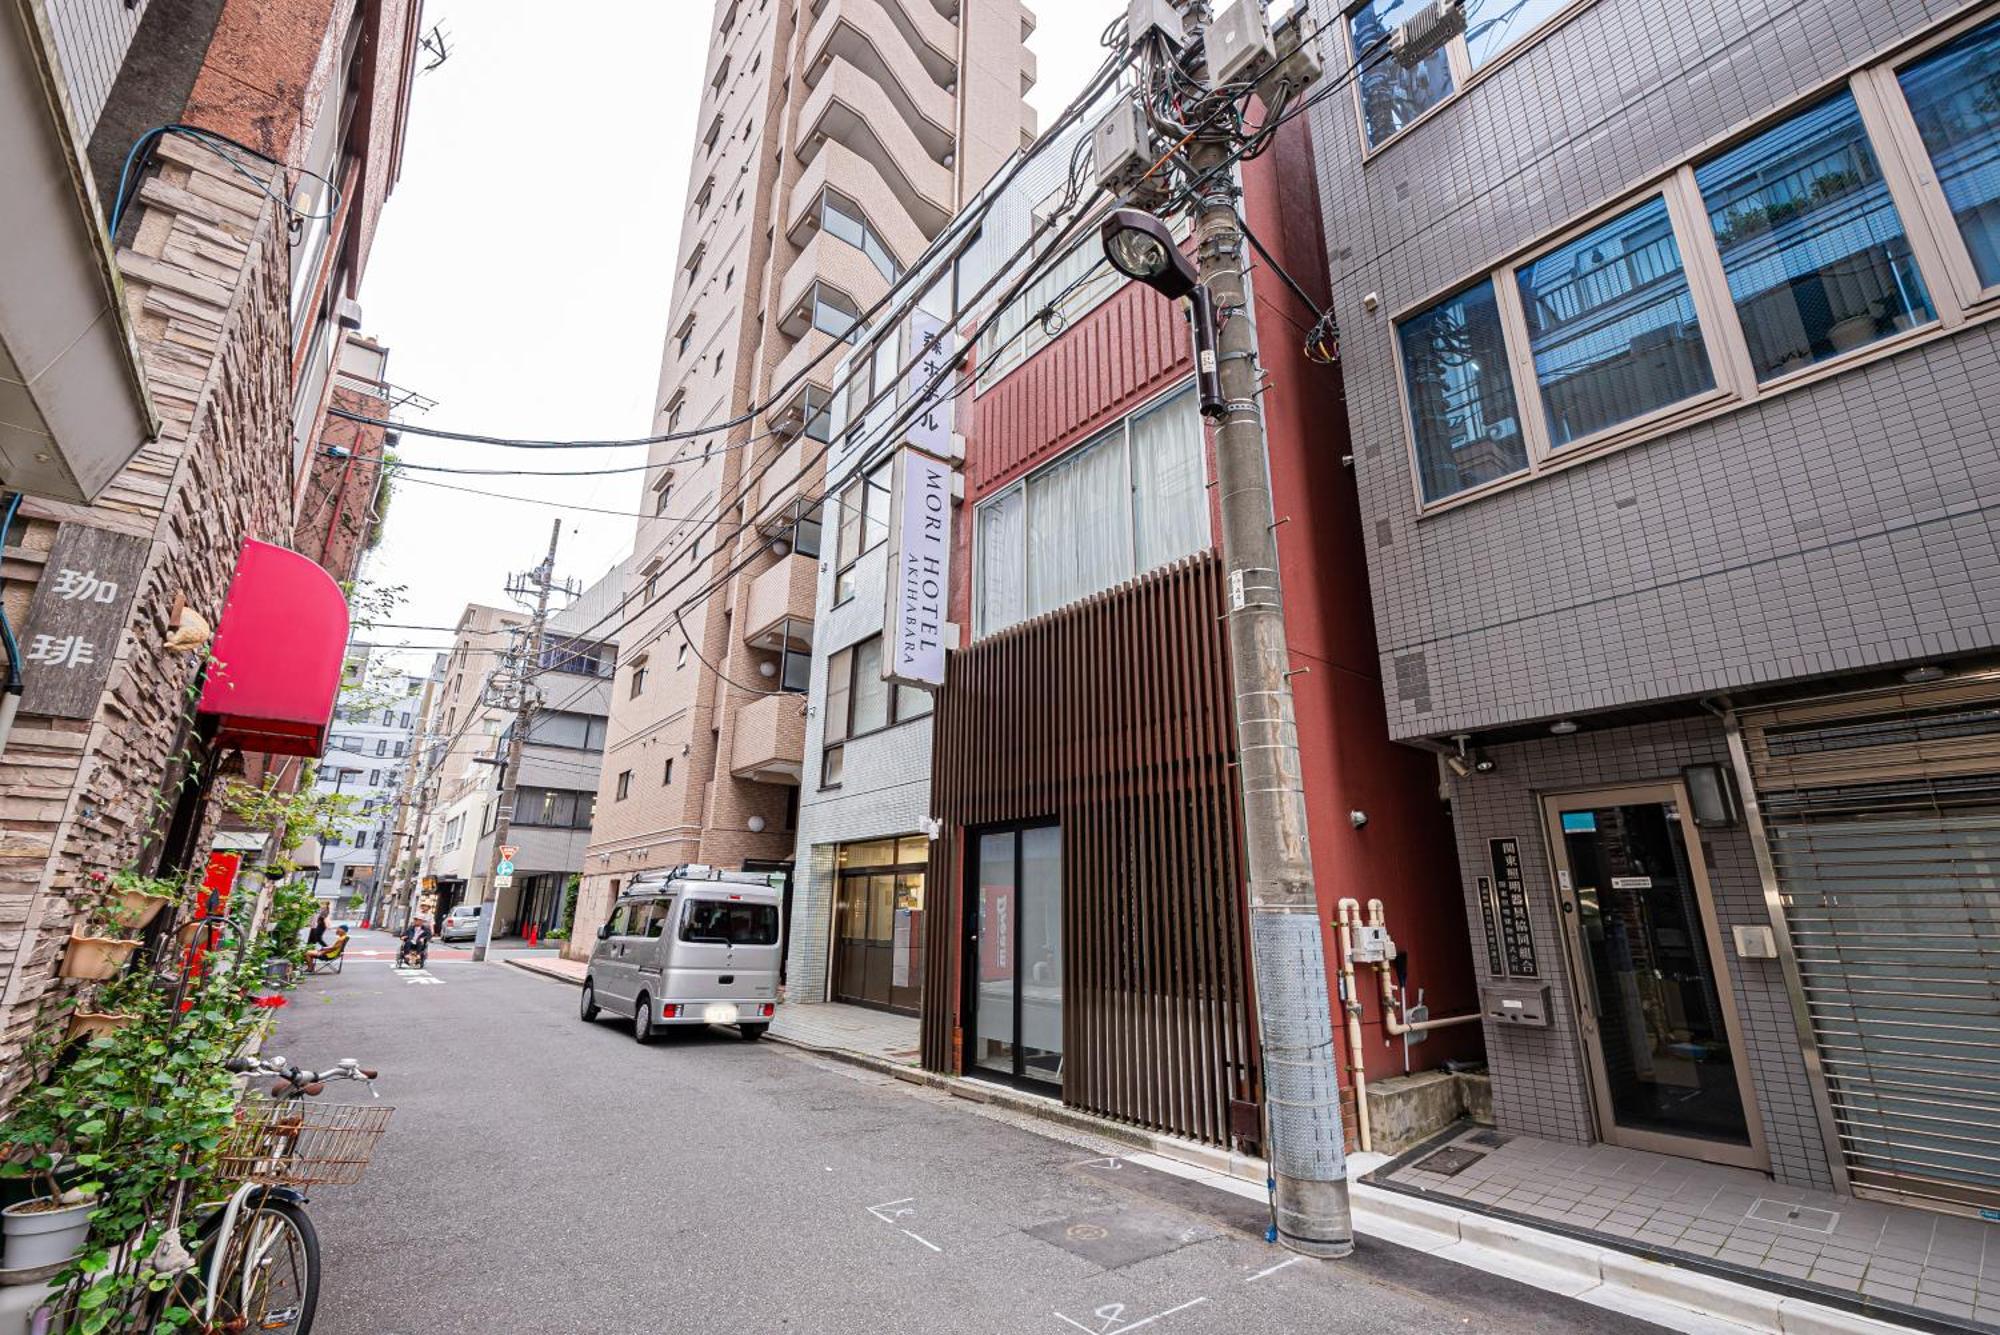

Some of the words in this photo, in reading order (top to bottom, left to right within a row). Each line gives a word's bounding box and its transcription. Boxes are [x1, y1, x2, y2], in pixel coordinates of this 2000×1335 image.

[925, 469, 943, 543] MORI
[28, 568, 118, 668] 珈琲
[903, 553, 919, 664] AKIHABARA
[920, 556, 941, 652] HOTEL
